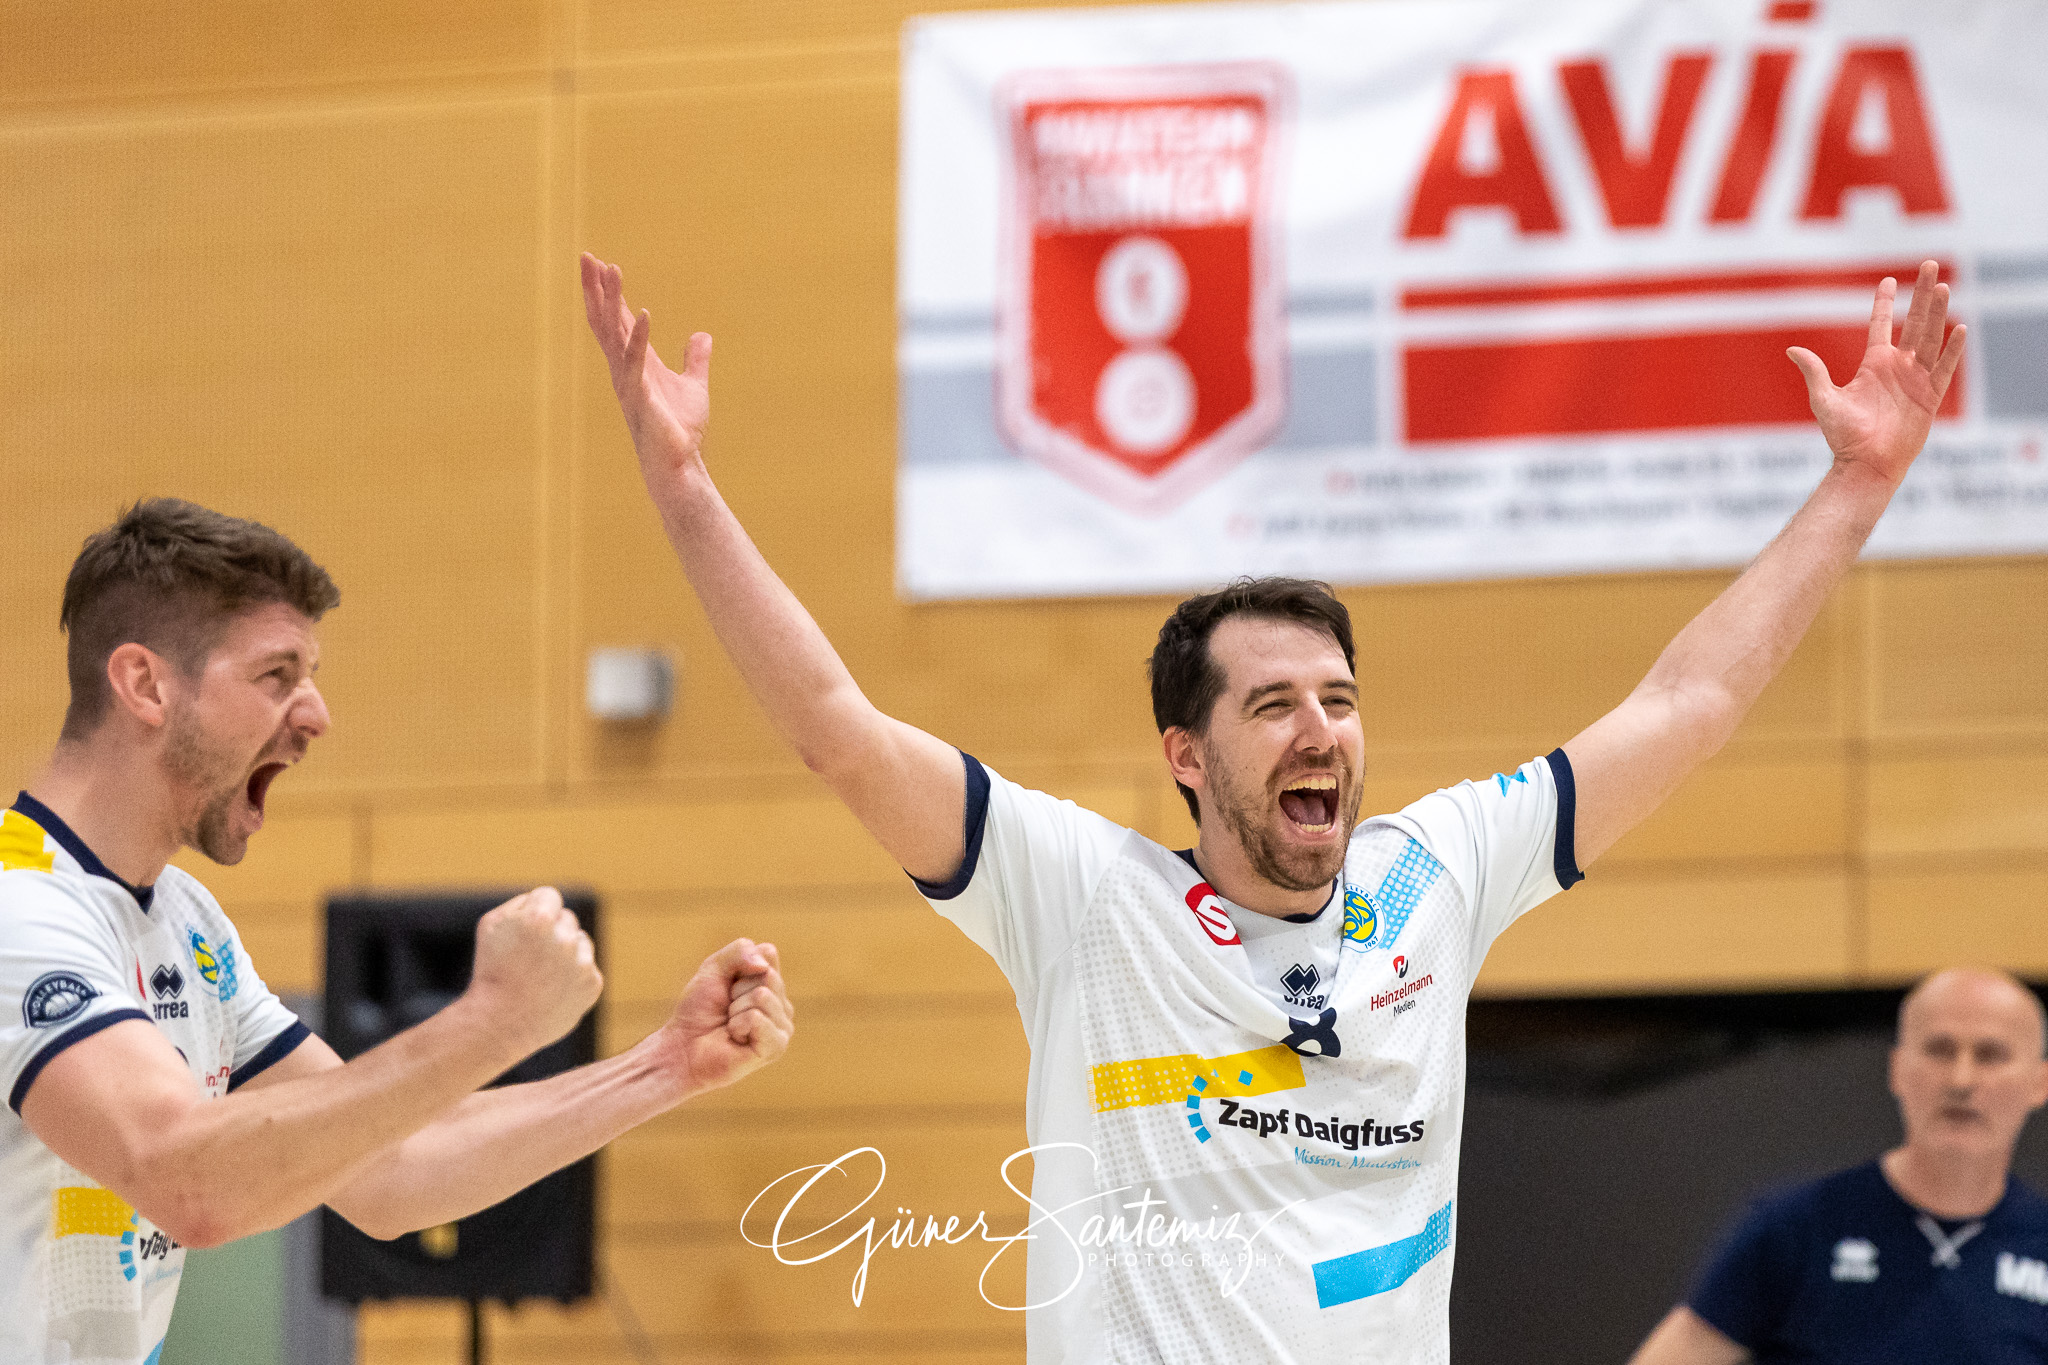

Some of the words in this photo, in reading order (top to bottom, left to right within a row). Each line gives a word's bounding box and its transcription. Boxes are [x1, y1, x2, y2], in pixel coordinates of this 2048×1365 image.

[1364, 935, 1379, 950] 1967
[1370, 973, 1433, 1011] Heinzelmann
[1393, 999, 1416, 1017] Medien
[1218, 1098, 1290, 1139] Zapf
[1294, 1112, 1425, 1151] Daigfuss
[1294, 1146, 1342, 1168] Mission
